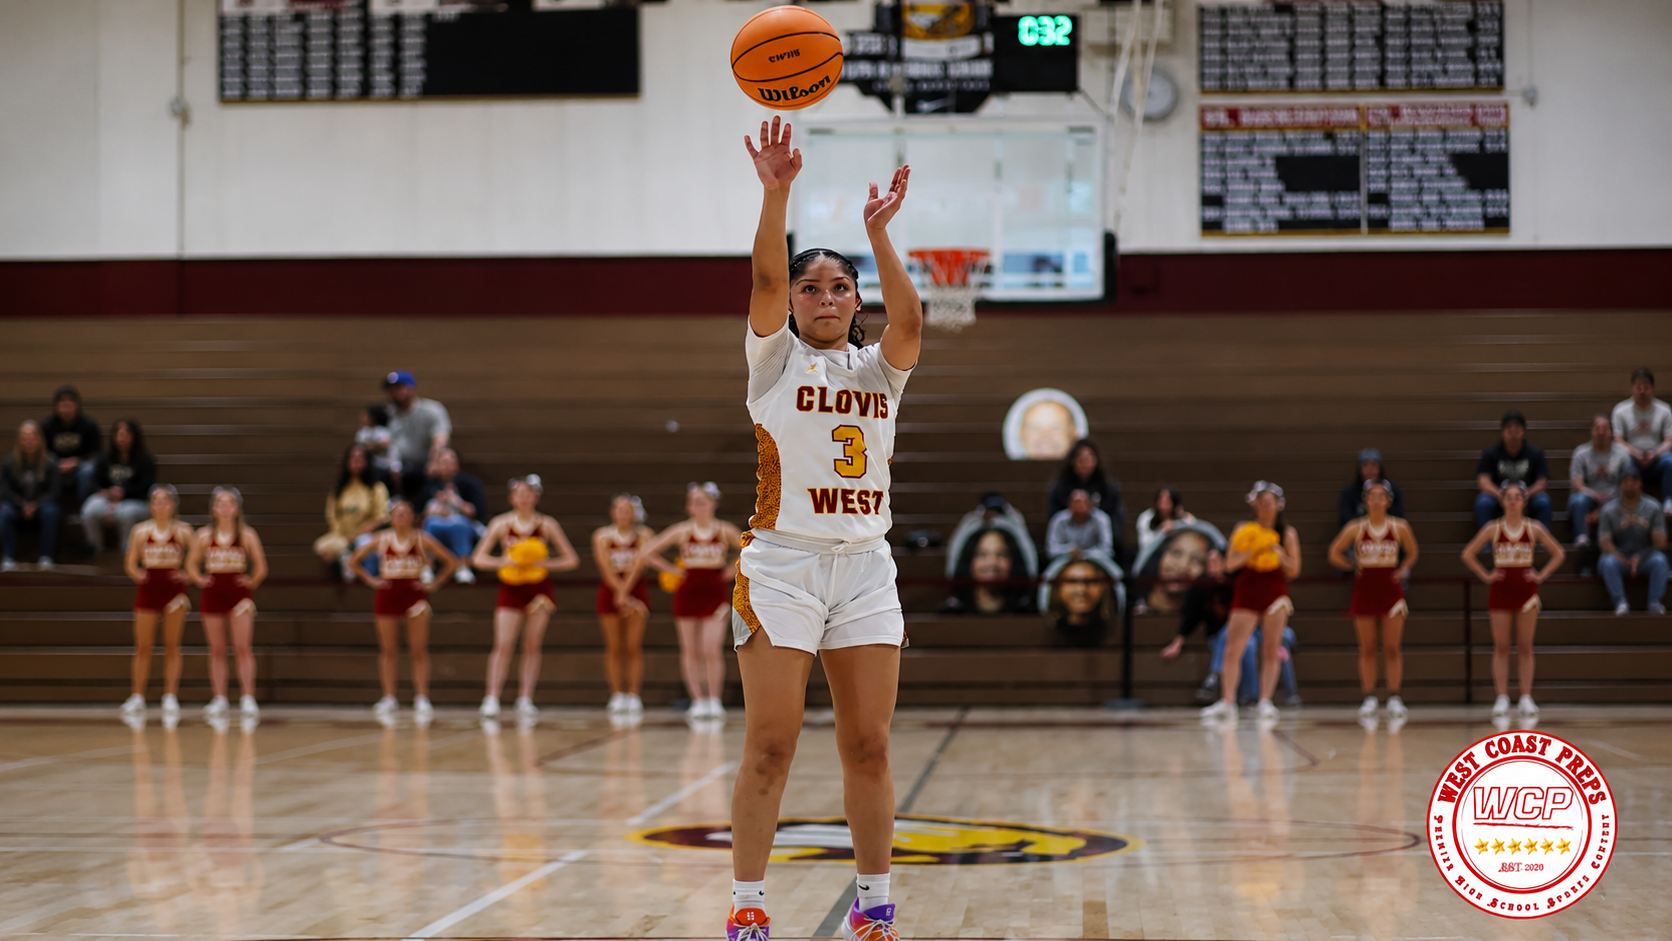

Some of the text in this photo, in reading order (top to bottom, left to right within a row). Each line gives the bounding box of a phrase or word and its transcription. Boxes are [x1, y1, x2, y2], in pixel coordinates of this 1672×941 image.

[757, 75, 831, 102] Wilson
[796, 385, 889, 419] CLOVIS
[831, 424, 868, 479] 3
[807, 488, 884, 515] WEST
